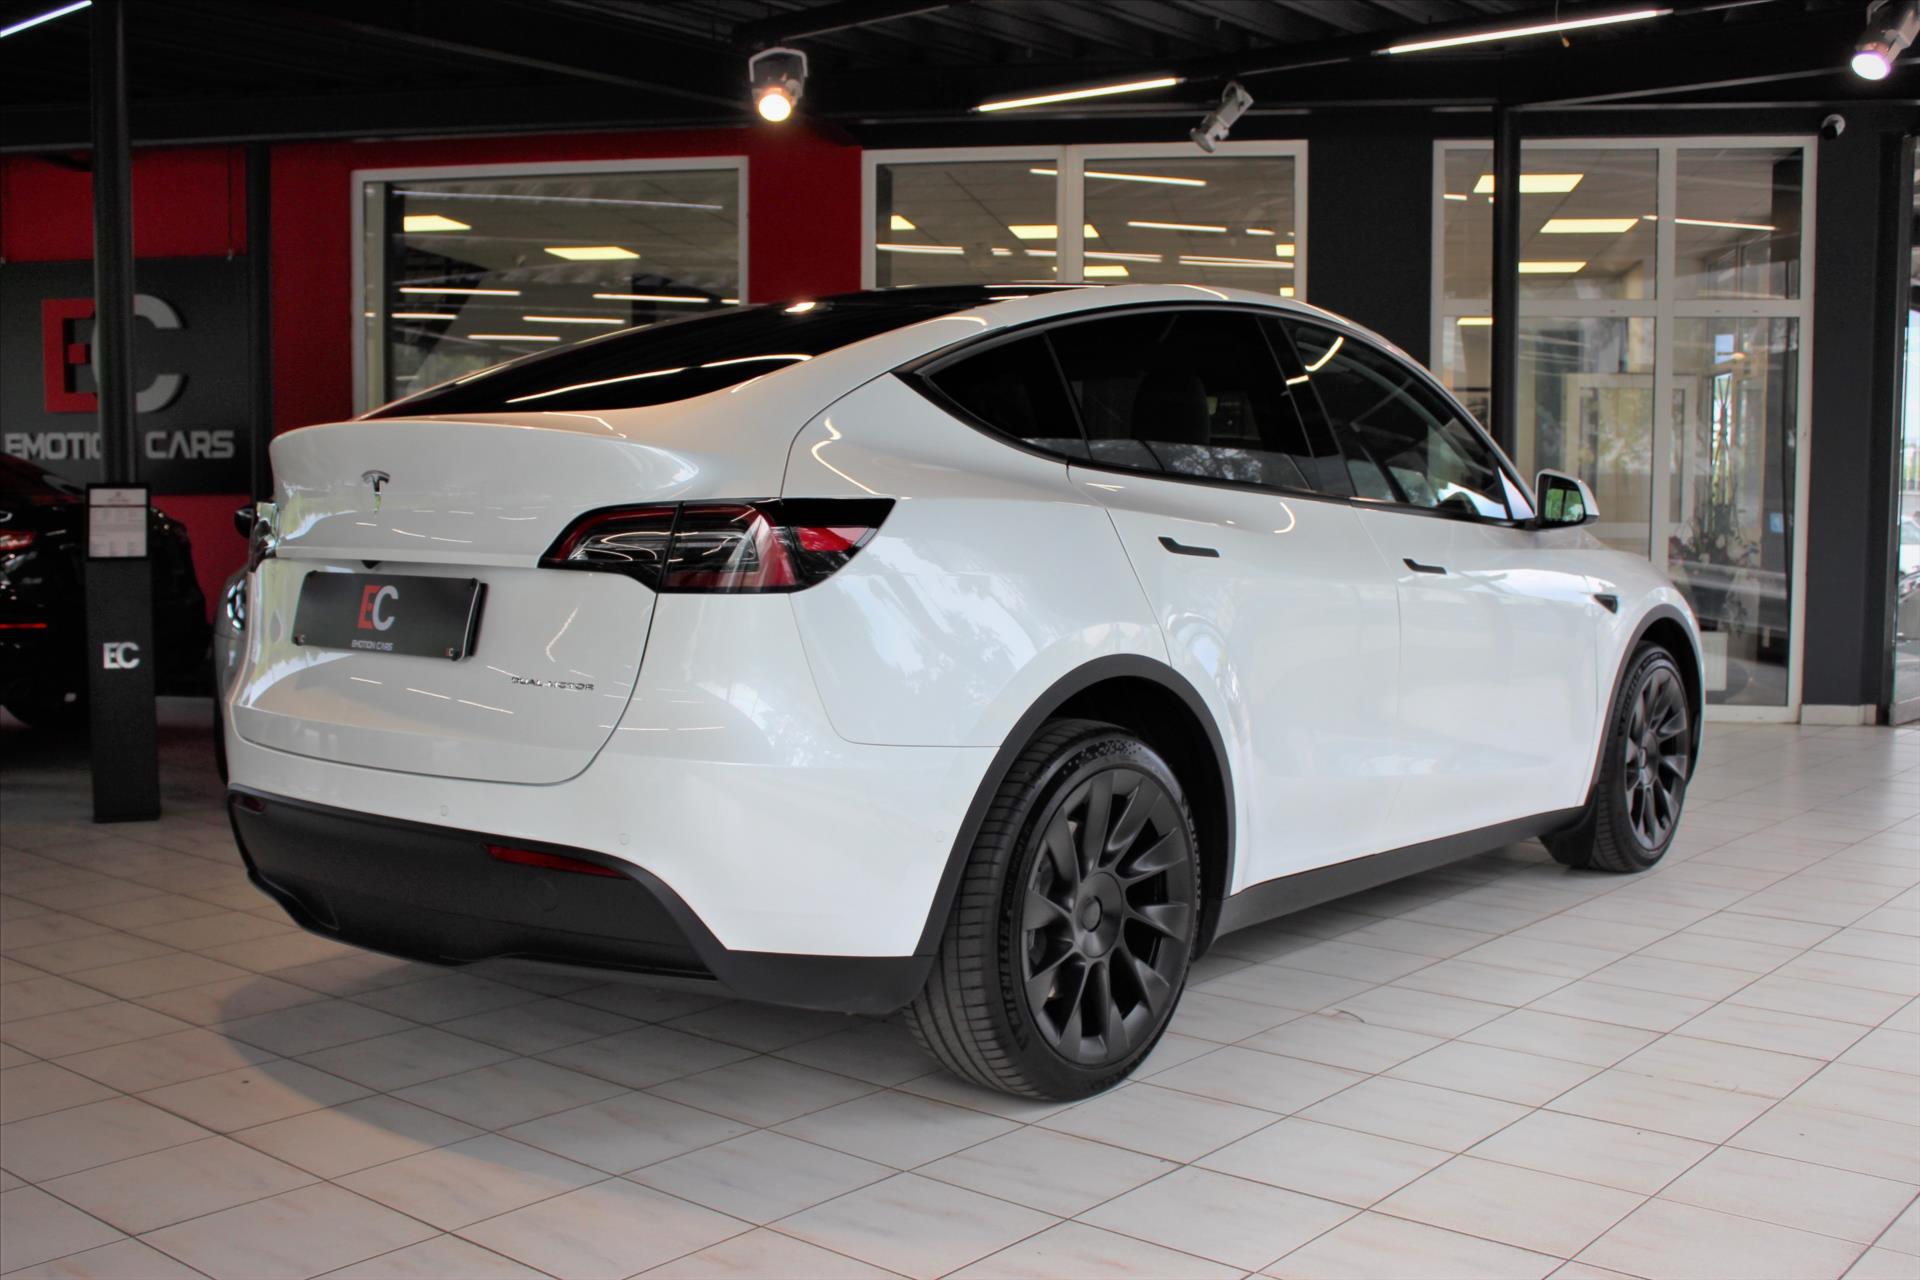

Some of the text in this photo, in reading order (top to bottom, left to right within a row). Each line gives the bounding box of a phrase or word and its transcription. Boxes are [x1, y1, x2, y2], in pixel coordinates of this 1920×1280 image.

[4, 430, 235, 460] EMOTI CARS
[357, 585, 399, 631] EC
[103, 641, 140, 669] EC
